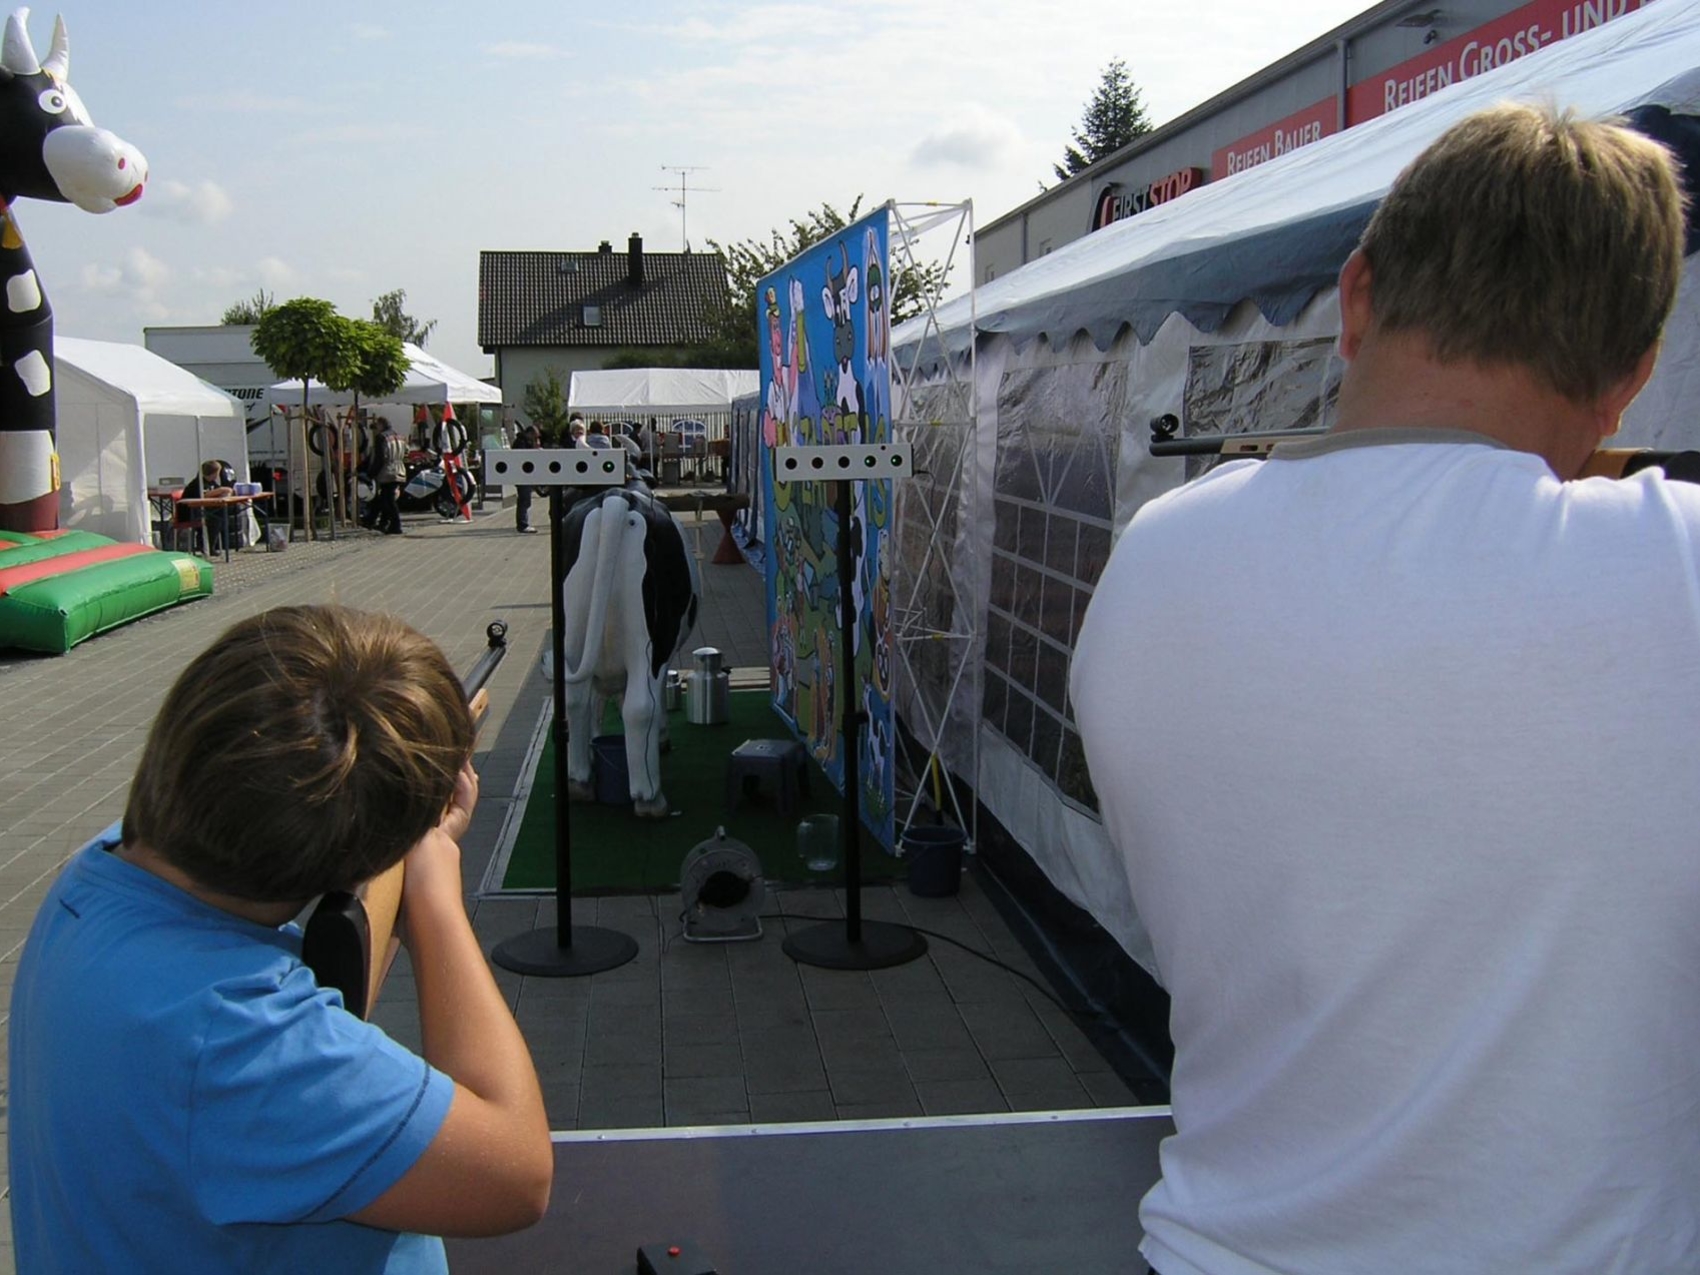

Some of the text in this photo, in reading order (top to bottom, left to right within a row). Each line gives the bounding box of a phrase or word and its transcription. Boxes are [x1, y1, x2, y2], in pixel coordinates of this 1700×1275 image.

[1384, 0, 1627, 113] REIFEN GROSS- UND
[1227, 121, 1321, 177] REIFEN BAUER
